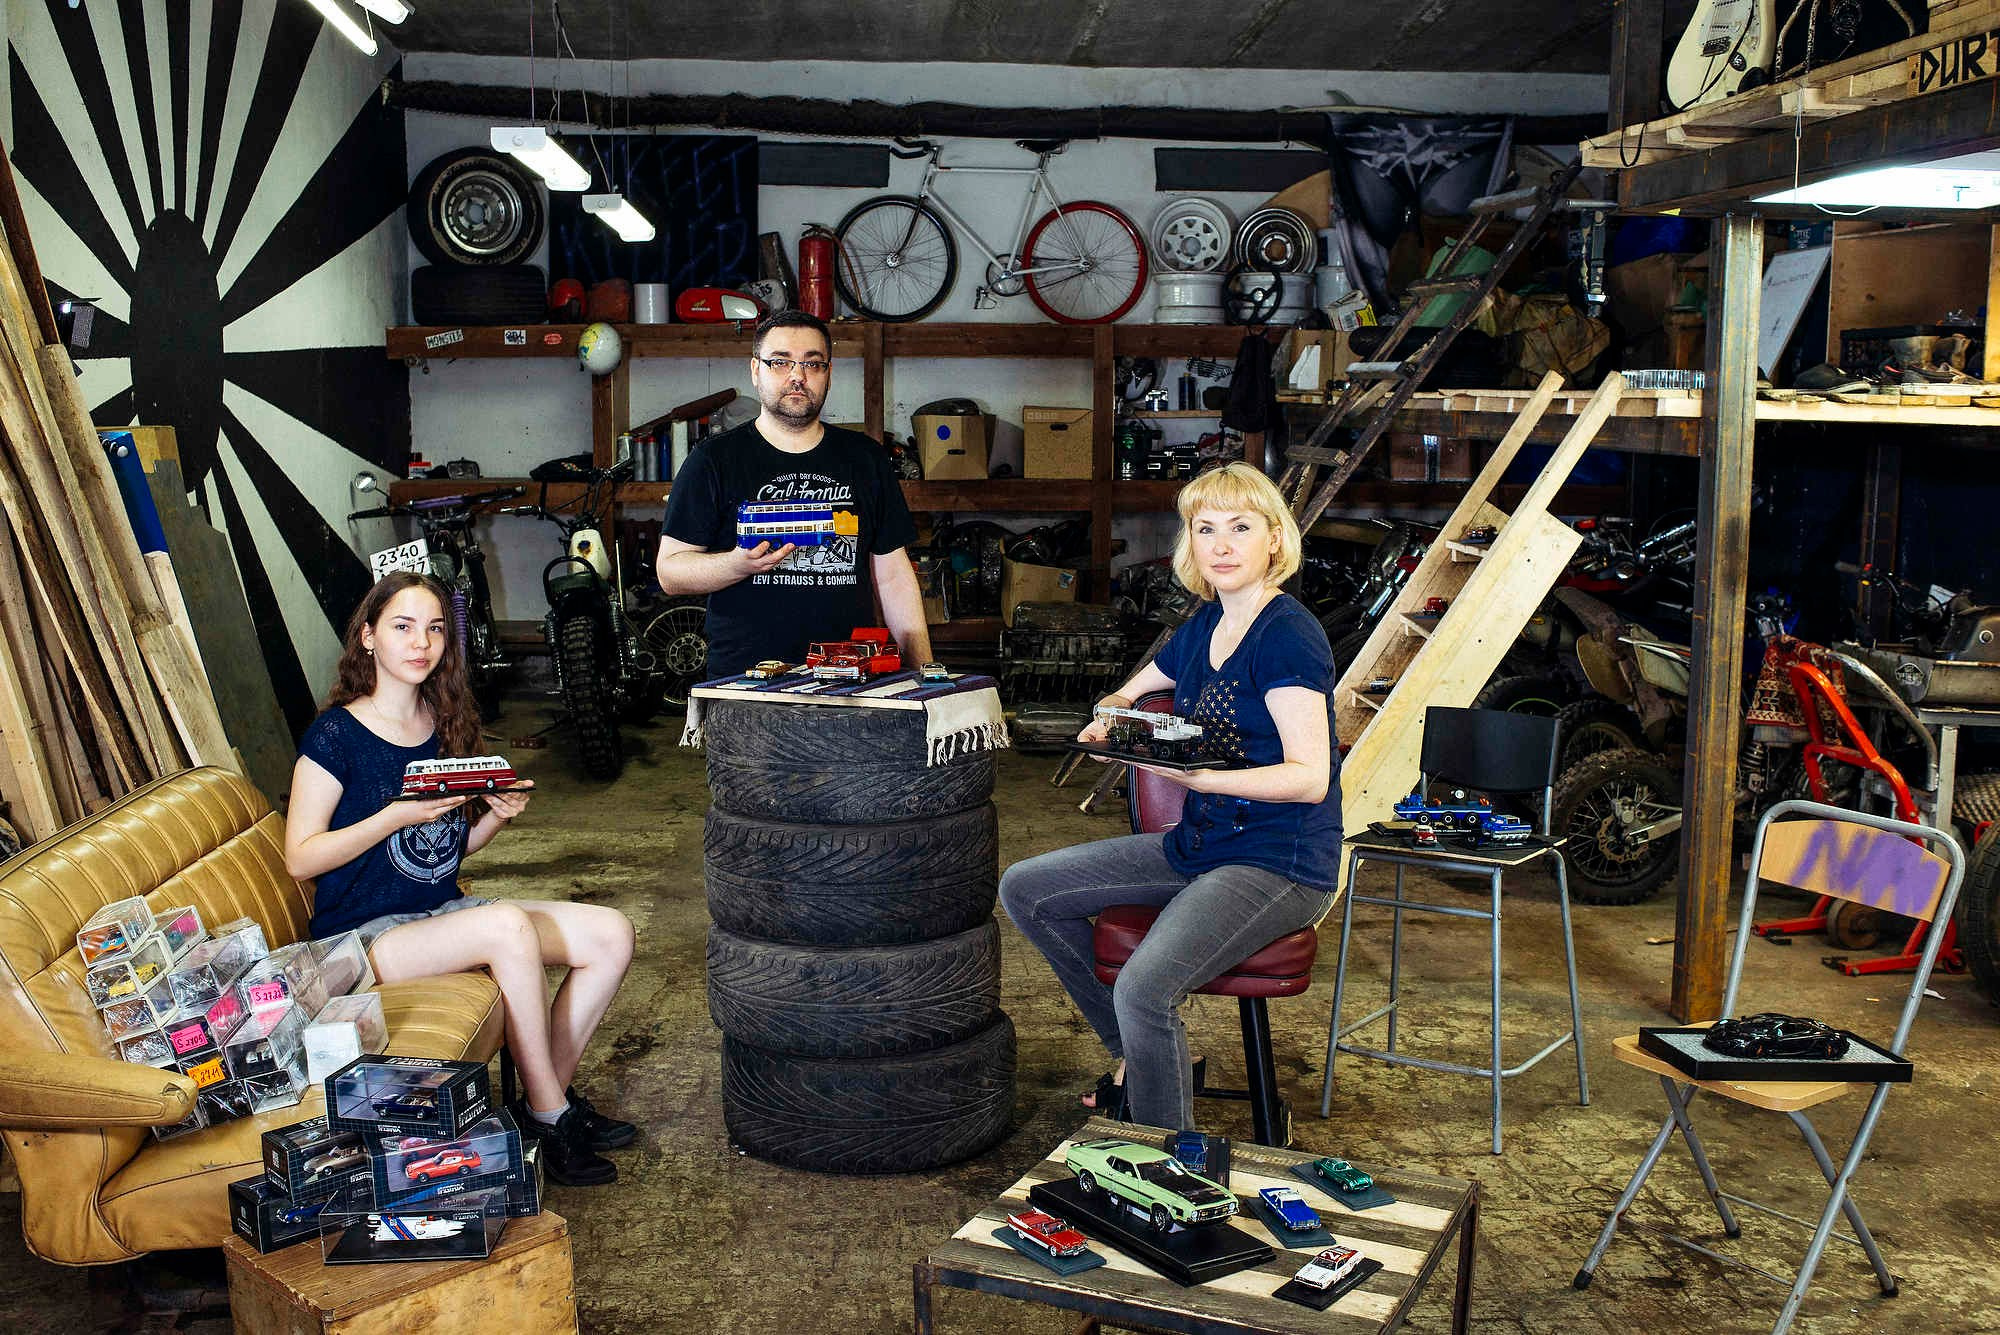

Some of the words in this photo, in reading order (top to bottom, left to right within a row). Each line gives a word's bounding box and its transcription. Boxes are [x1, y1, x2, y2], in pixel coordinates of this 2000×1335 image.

[752, 575, 770, 585] LEVI
[773, 575, 815, 586] STRAUSS
[817, 575, 824, 586] &
